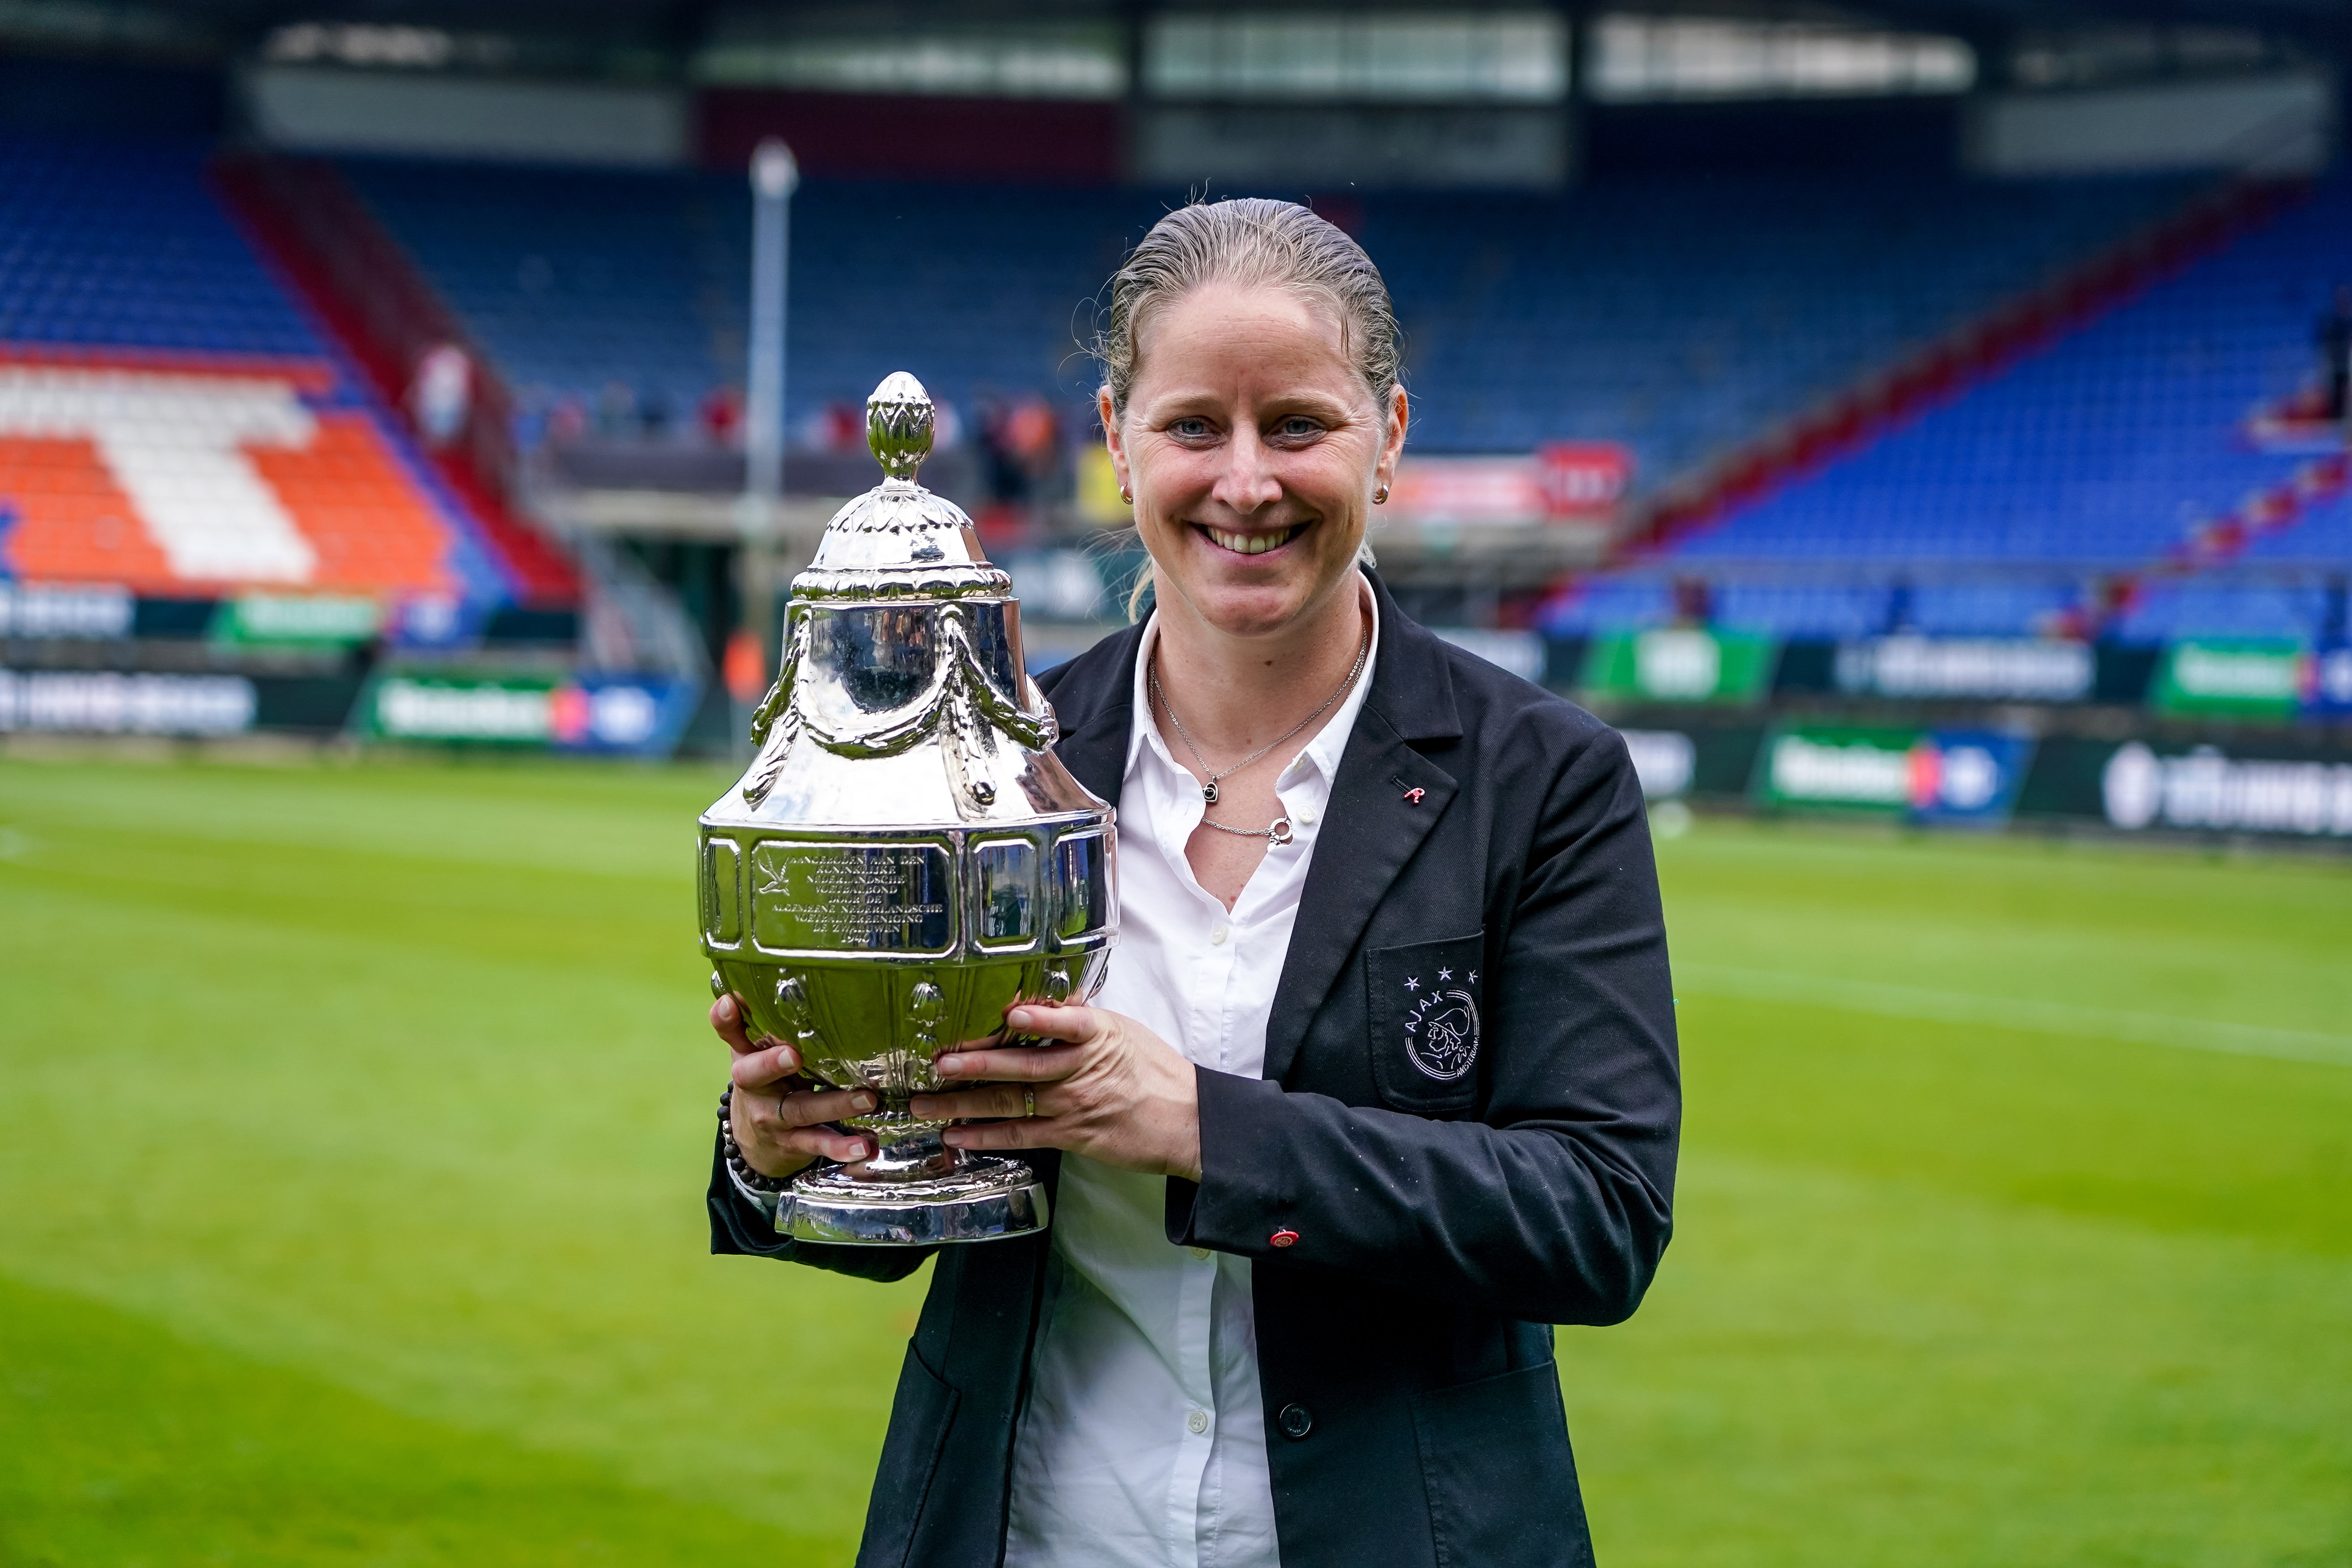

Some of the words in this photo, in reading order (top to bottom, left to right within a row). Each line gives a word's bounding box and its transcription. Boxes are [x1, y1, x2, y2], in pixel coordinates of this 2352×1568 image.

[790, 856, 864, 864] AANGEBODEN
[870, 856, 894, 865] AAN
[900, 856, 925, 865] DEN
[816, 866, 896, 874] KONINKLIJKE
[866, 895, 882, 904] DE
[813, 924, 827, 932] DE
[1405, 990, 1443, 1033] AJAX
[1456, 1036, 1480, 1077] AMSTERDAM
